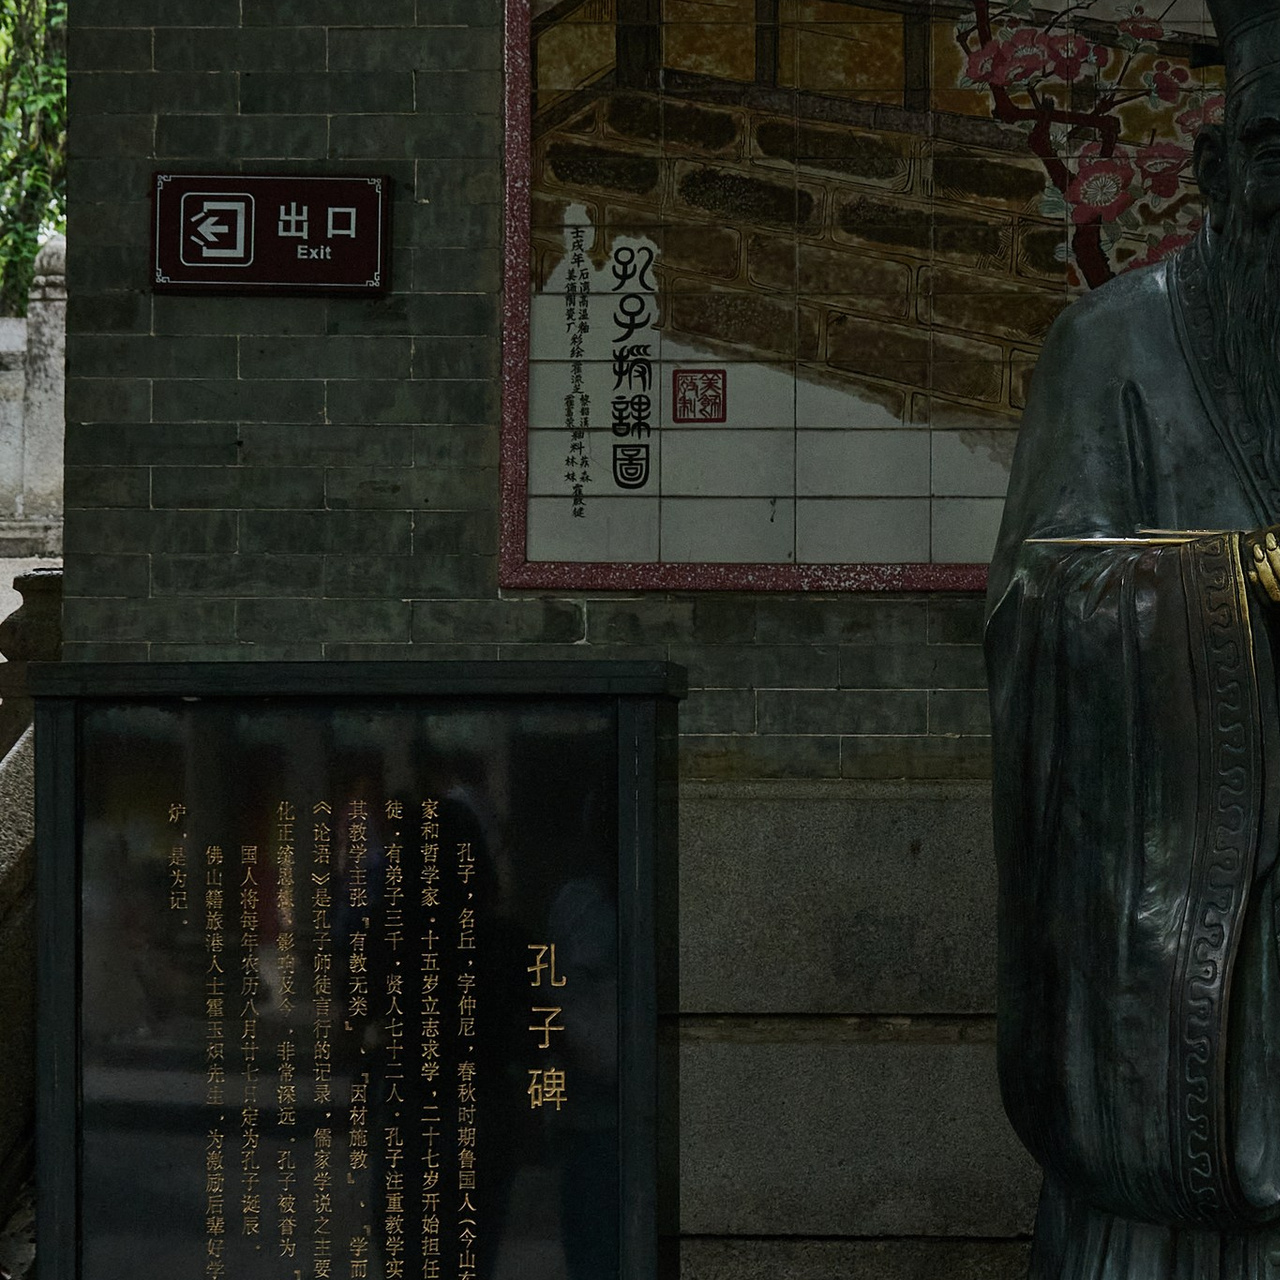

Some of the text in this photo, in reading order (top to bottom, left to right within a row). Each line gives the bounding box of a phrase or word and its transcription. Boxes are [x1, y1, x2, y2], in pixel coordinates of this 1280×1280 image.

[278, 201, 357, 240] 出口
[297, 245, 332, 260] Exit
[527, 943, 568, 1111] 孔子碑
